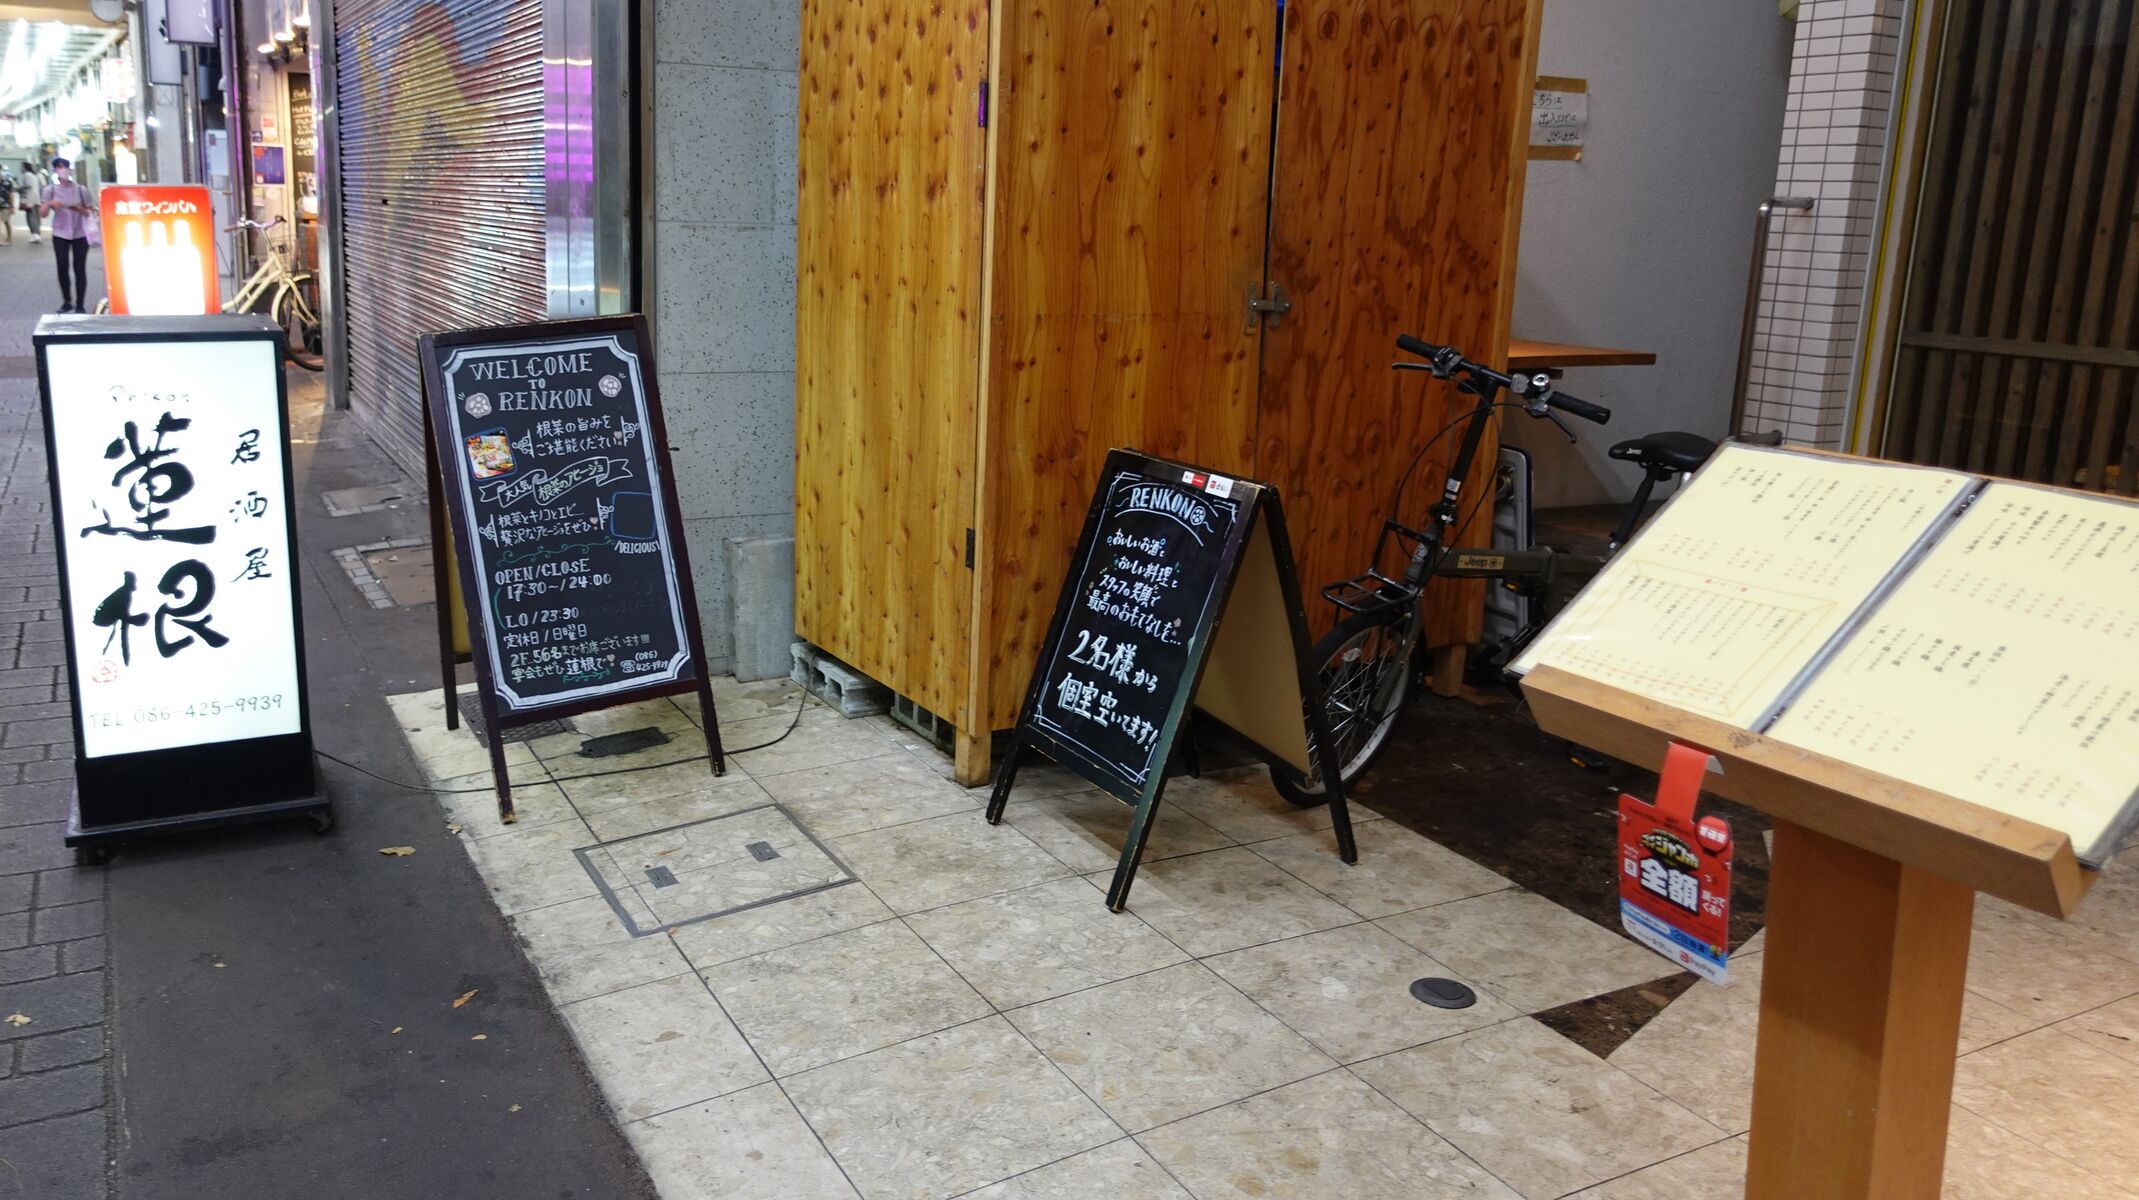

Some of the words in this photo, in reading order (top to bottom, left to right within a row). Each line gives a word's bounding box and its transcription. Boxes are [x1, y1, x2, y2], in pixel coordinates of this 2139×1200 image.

[469, 353, 593, 380] WELCOME
[498, 388, 593, 411] RENKON
[528, 378, 546, 389] TO
[536, 414, 612, 438] 根菜の旨みを
[229, 428, 272, 583] 居酒屋
[1129, 487, 1196, 520] RENKON
[80, 411, 230, 666] 蓮根
[1118, 556, 1178, 588] おいしい料理と
[1067, 629, 1158, 693] 2名様から
[134, 695, 282, 724] 086-425-9939
[1640, 858, 1698, 912] 全額
